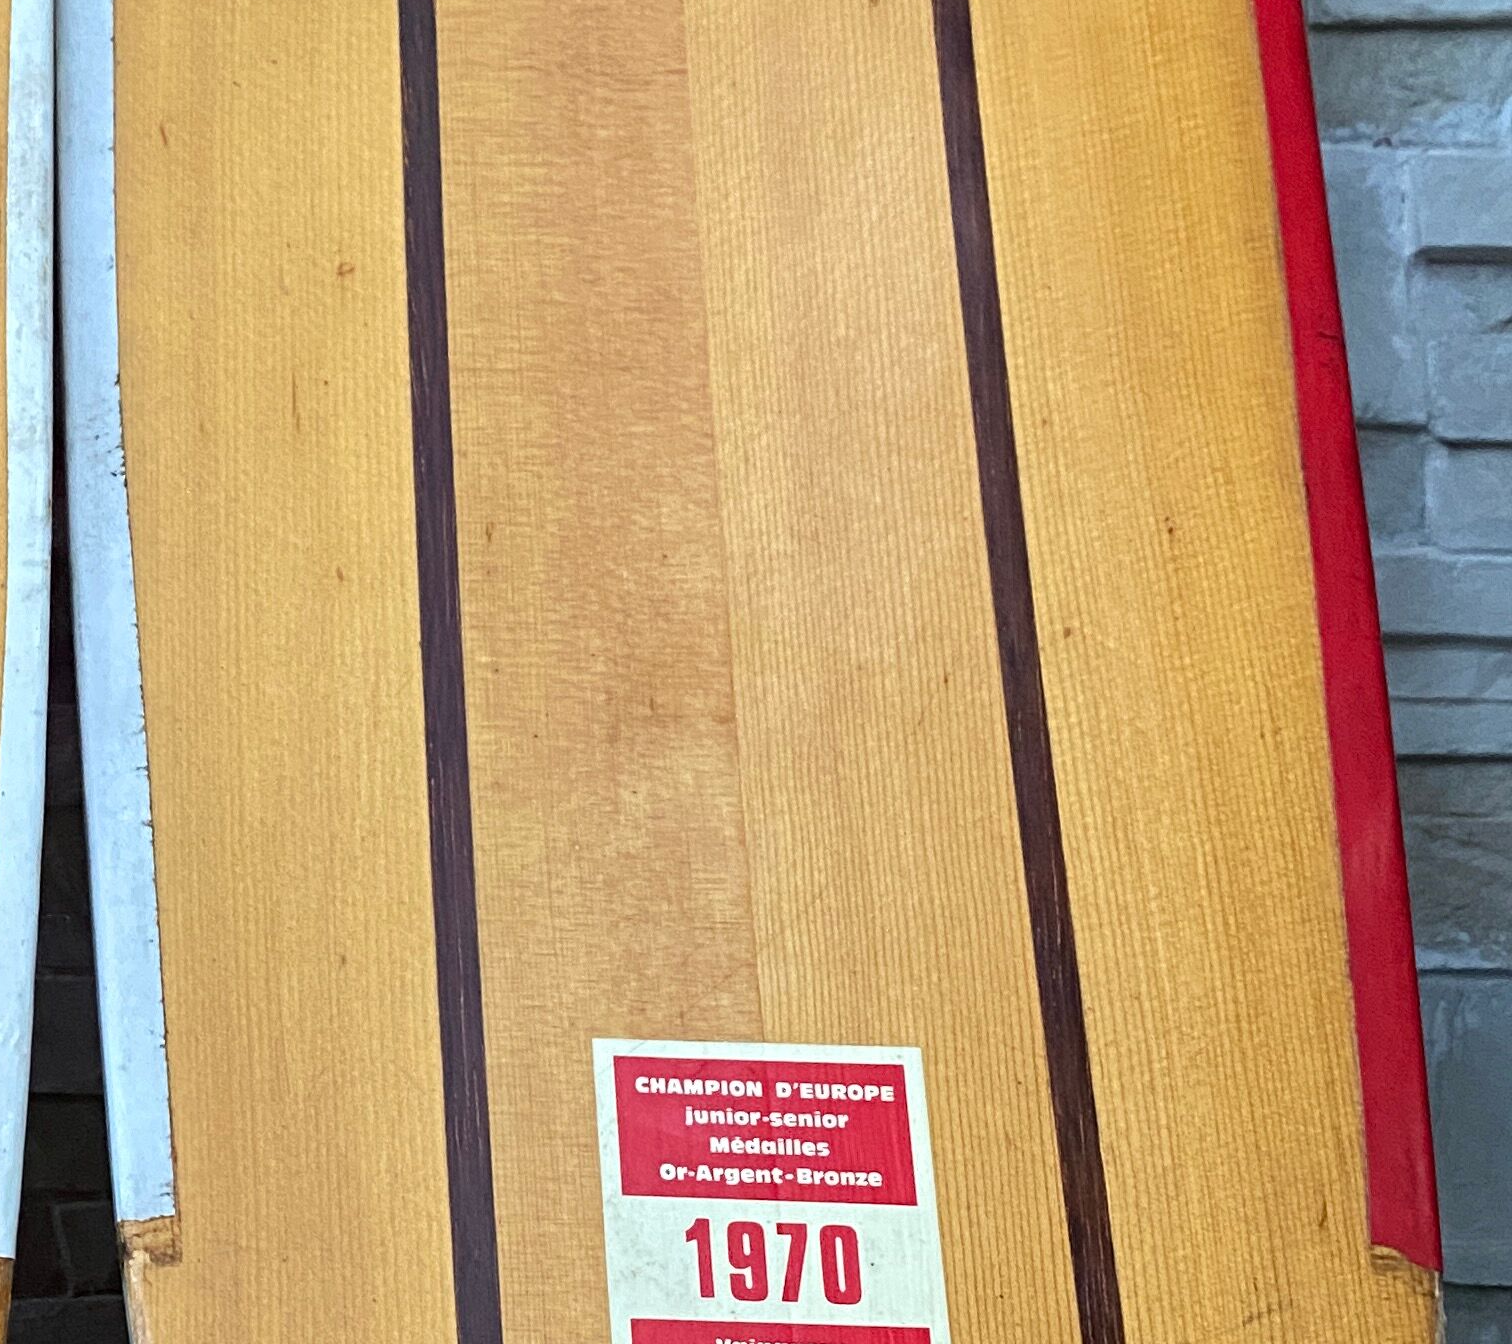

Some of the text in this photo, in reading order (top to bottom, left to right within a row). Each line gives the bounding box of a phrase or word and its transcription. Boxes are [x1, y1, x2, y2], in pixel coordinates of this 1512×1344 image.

[635, 1076, 895, 1102] CHAMPION D'EUROPE
[685, 1106, 849, 1129] junior-senior
[685, 1217, 863, 1305] 1970
